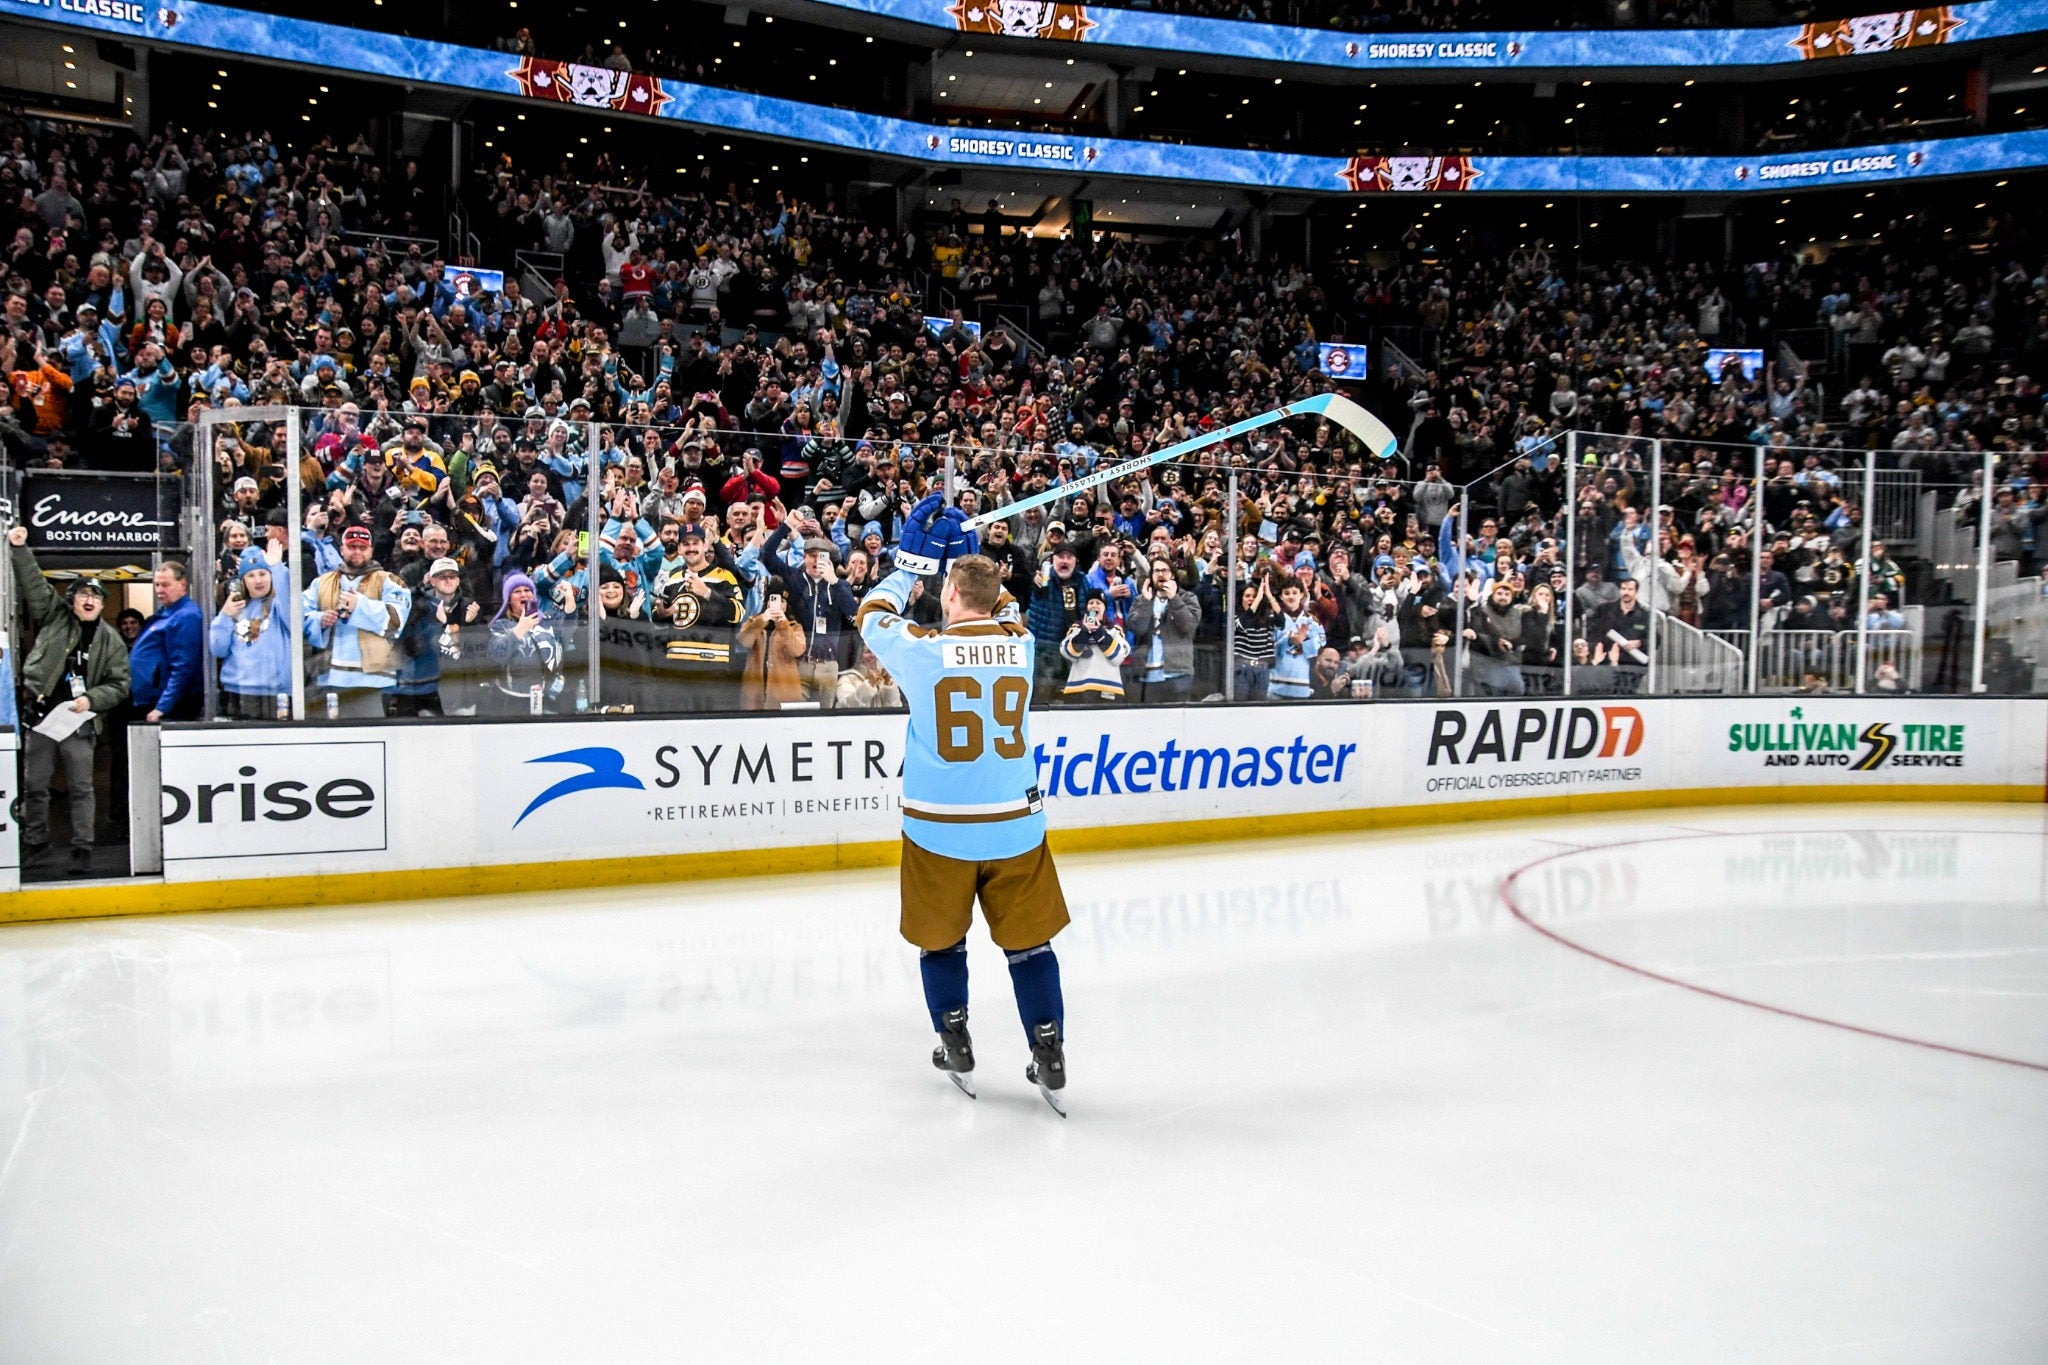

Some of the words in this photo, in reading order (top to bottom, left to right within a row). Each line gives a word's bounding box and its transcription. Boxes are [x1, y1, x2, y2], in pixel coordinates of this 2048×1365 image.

[60, 0, 144, 23] CLASSIC
[1369, 43, 1435, 59] SHORESY
[1438, 42, 1497, 58] CLASSIC
[950, 138, 1014, 156] SHORESY
[1017, 143, 1074, 160] CLASSIC
[1760, 160, 1830, 180] SHORESY
[1832, 154, 1897, 174] CLASSIC
[1109, 455, 1152, 476] SHORESY
[1061, 476, 1096, 493] CLASSIC
[31, 493, 175, 527] Encore
[46, 530, 102, 542] BOSTON
[106, 532, 161, 542] HARBOR
[685, 524, 694, 533] B
[955, 645, 1018, 665] SHORE
[934, 676, 1029, 762] 69
[1426, 706, 1645, 766] RAPID7
[1728, 723, 1857, 752] SULLIVAN
[1902, 724, 1966, 752] TIRE
[655, 740, 904, 789] SYMETR
[1034, 734, 1357, 797] ticketmaster
[1765, 754, 1799, 767] AND
[1806, 754, 1850, 767] AUTO
[1891, 754, 1963, 767] SERVICE
[1426, 775, 1485, 792] OFFICIAL
[1488, 770, 1588, 788] CYBERSECURITY
[1588, 768, 1642, 782] PARTNER
[655, 801, 775, 821] RETIREMENT
[794, 796, 879, 813] BENEFITS
